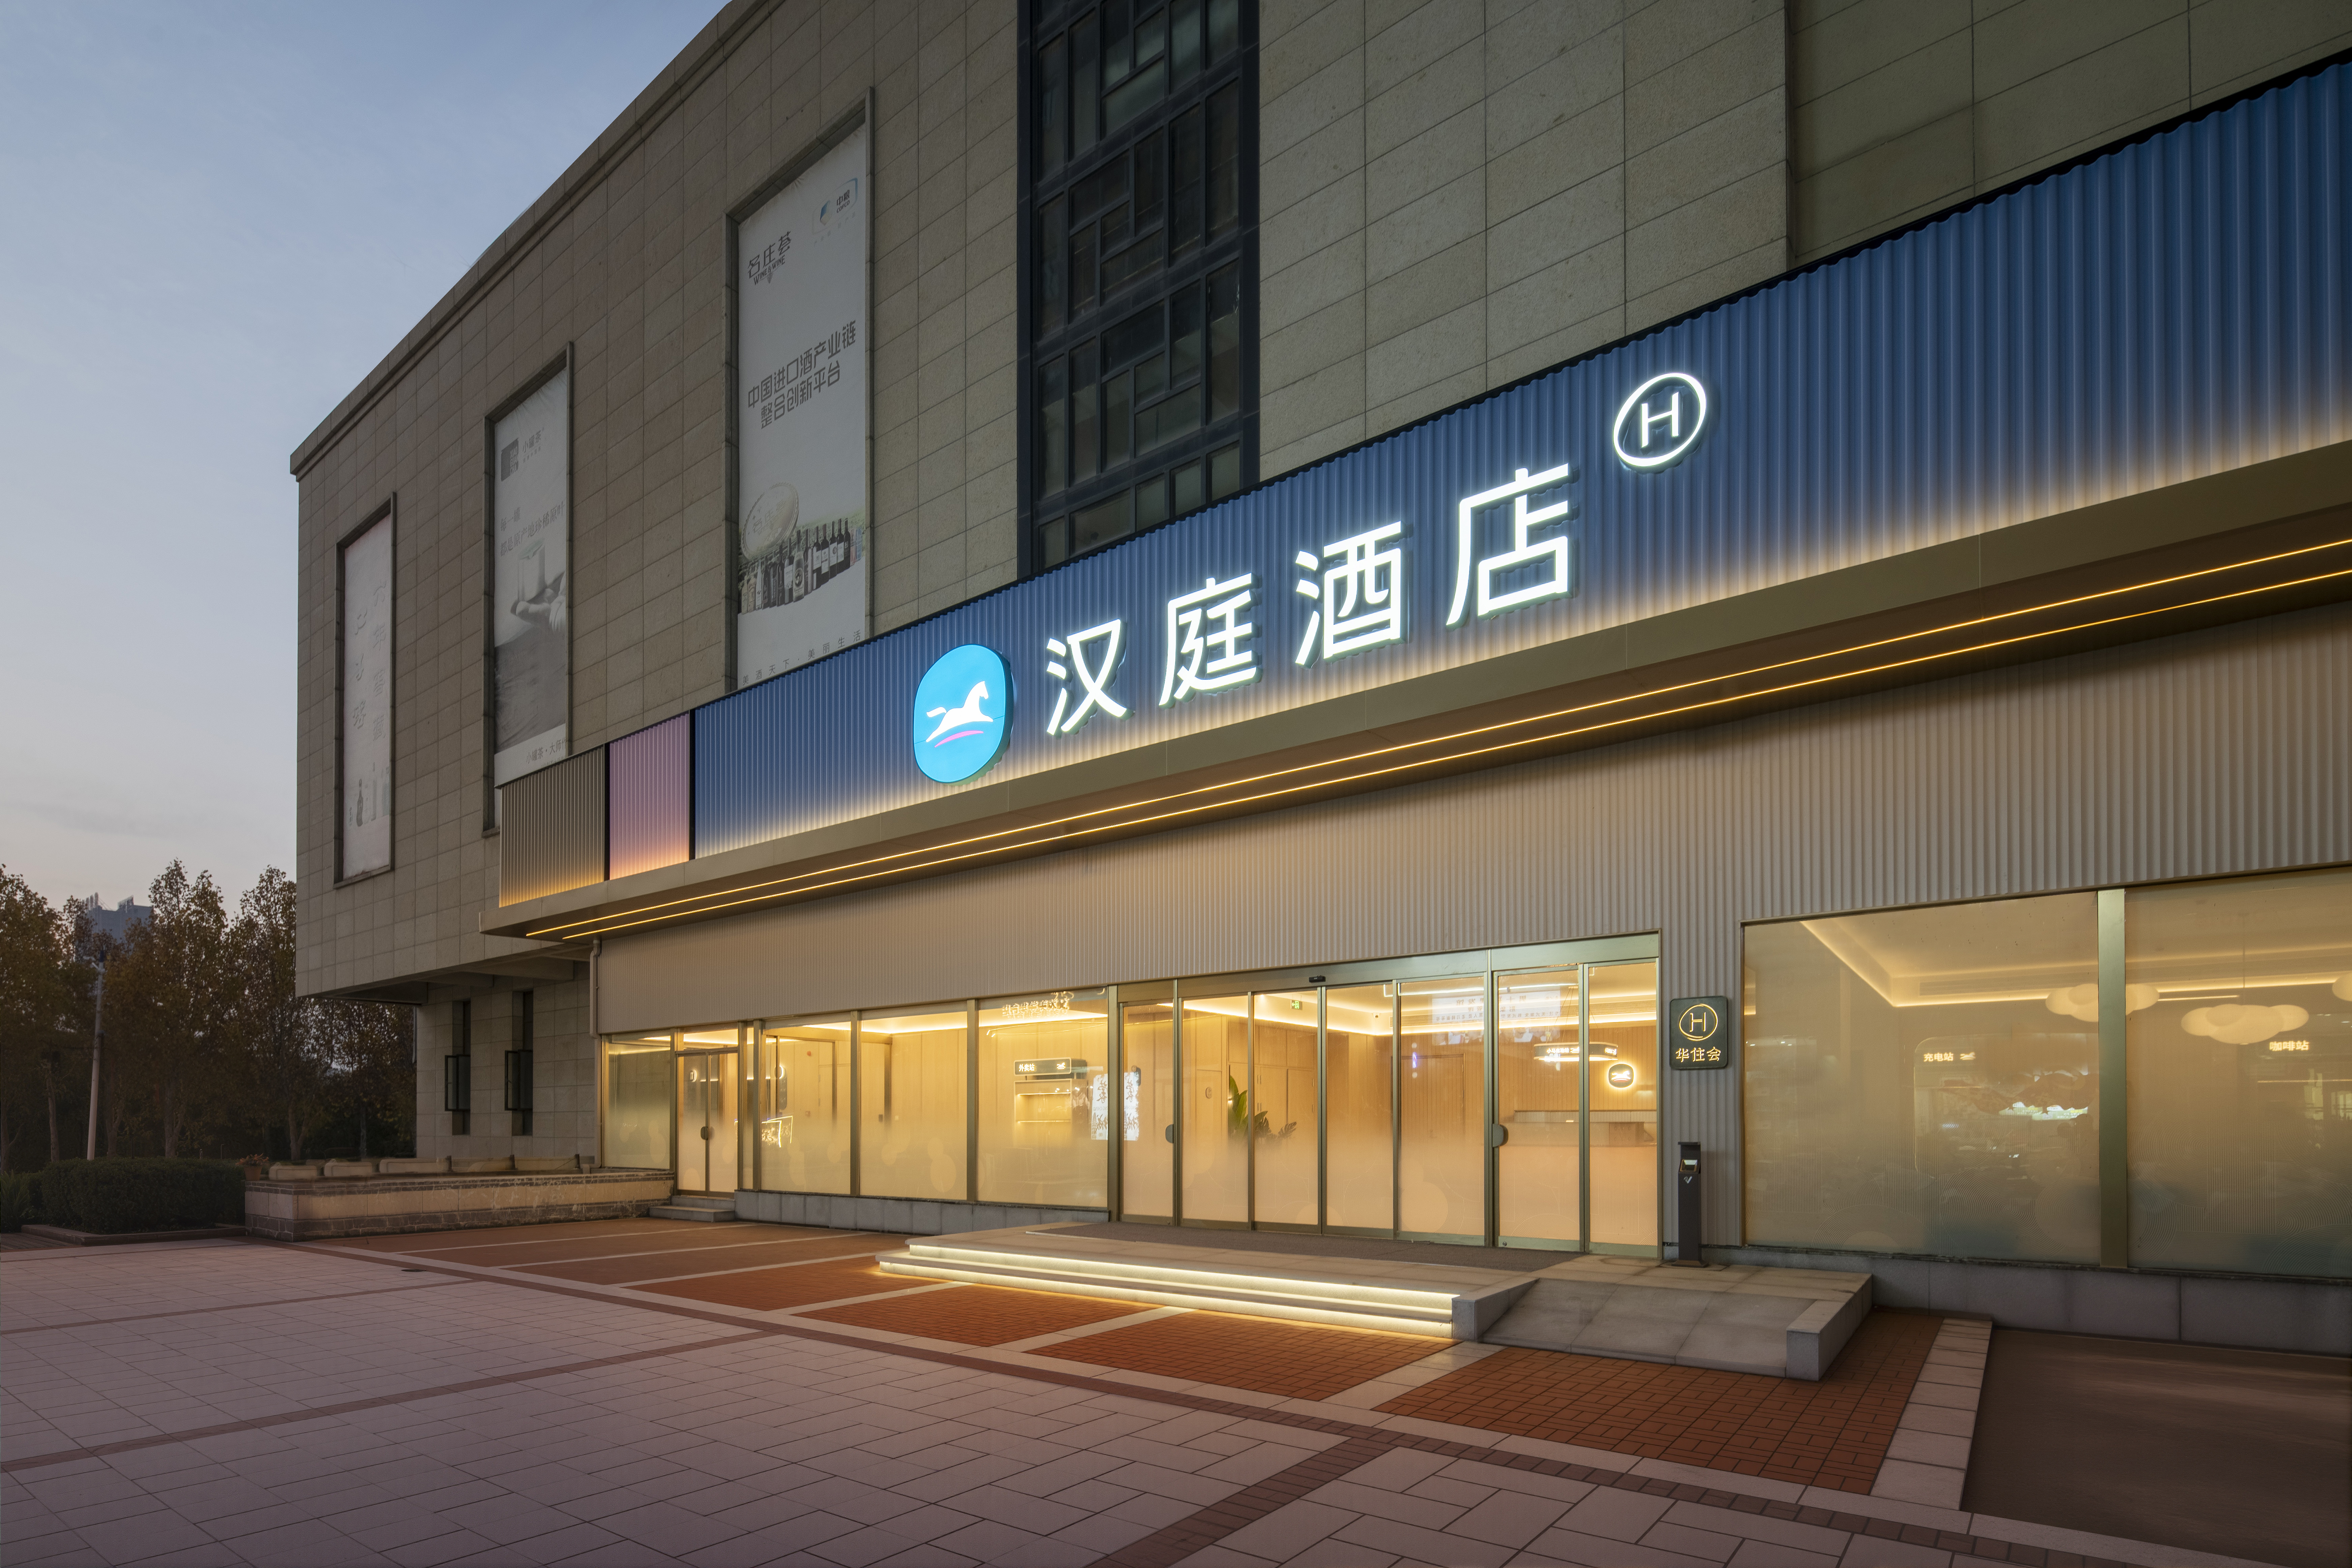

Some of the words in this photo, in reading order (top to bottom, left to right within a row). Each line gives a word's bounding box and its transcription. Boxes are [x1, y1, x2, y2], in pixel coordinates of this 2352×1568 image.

[836, 189, 850, 206] 中粮
[836, 200, 850, 213] COFCO
[747, 230, 791, 279] 名庄荟
[753, 269, 768, 286] WINE
[771, 254, 786, 271] WINE
[748, 319, 856, 409] 中国进口酒产业链
[760, 360, 840, 430] 整合创新平台
[522, 430, 541, 454] 小罐茶
[510, 454, 519, 466] GUAN
[500, 501, 565, 557] 都是原产地珍稀原叶
[1046, 462, 1569, 736] 汉庭酒店
[742, 629, 861, 686] 美酒天下·美丽生活
[1675, 1046, 1722, 1063] 华住会
[1923, 1052, 1954, 1062] 充电站
[2269, 1040, 2309, 1052] 咖啡站
[1018, 1063, 1035, 1072] 外卖站
